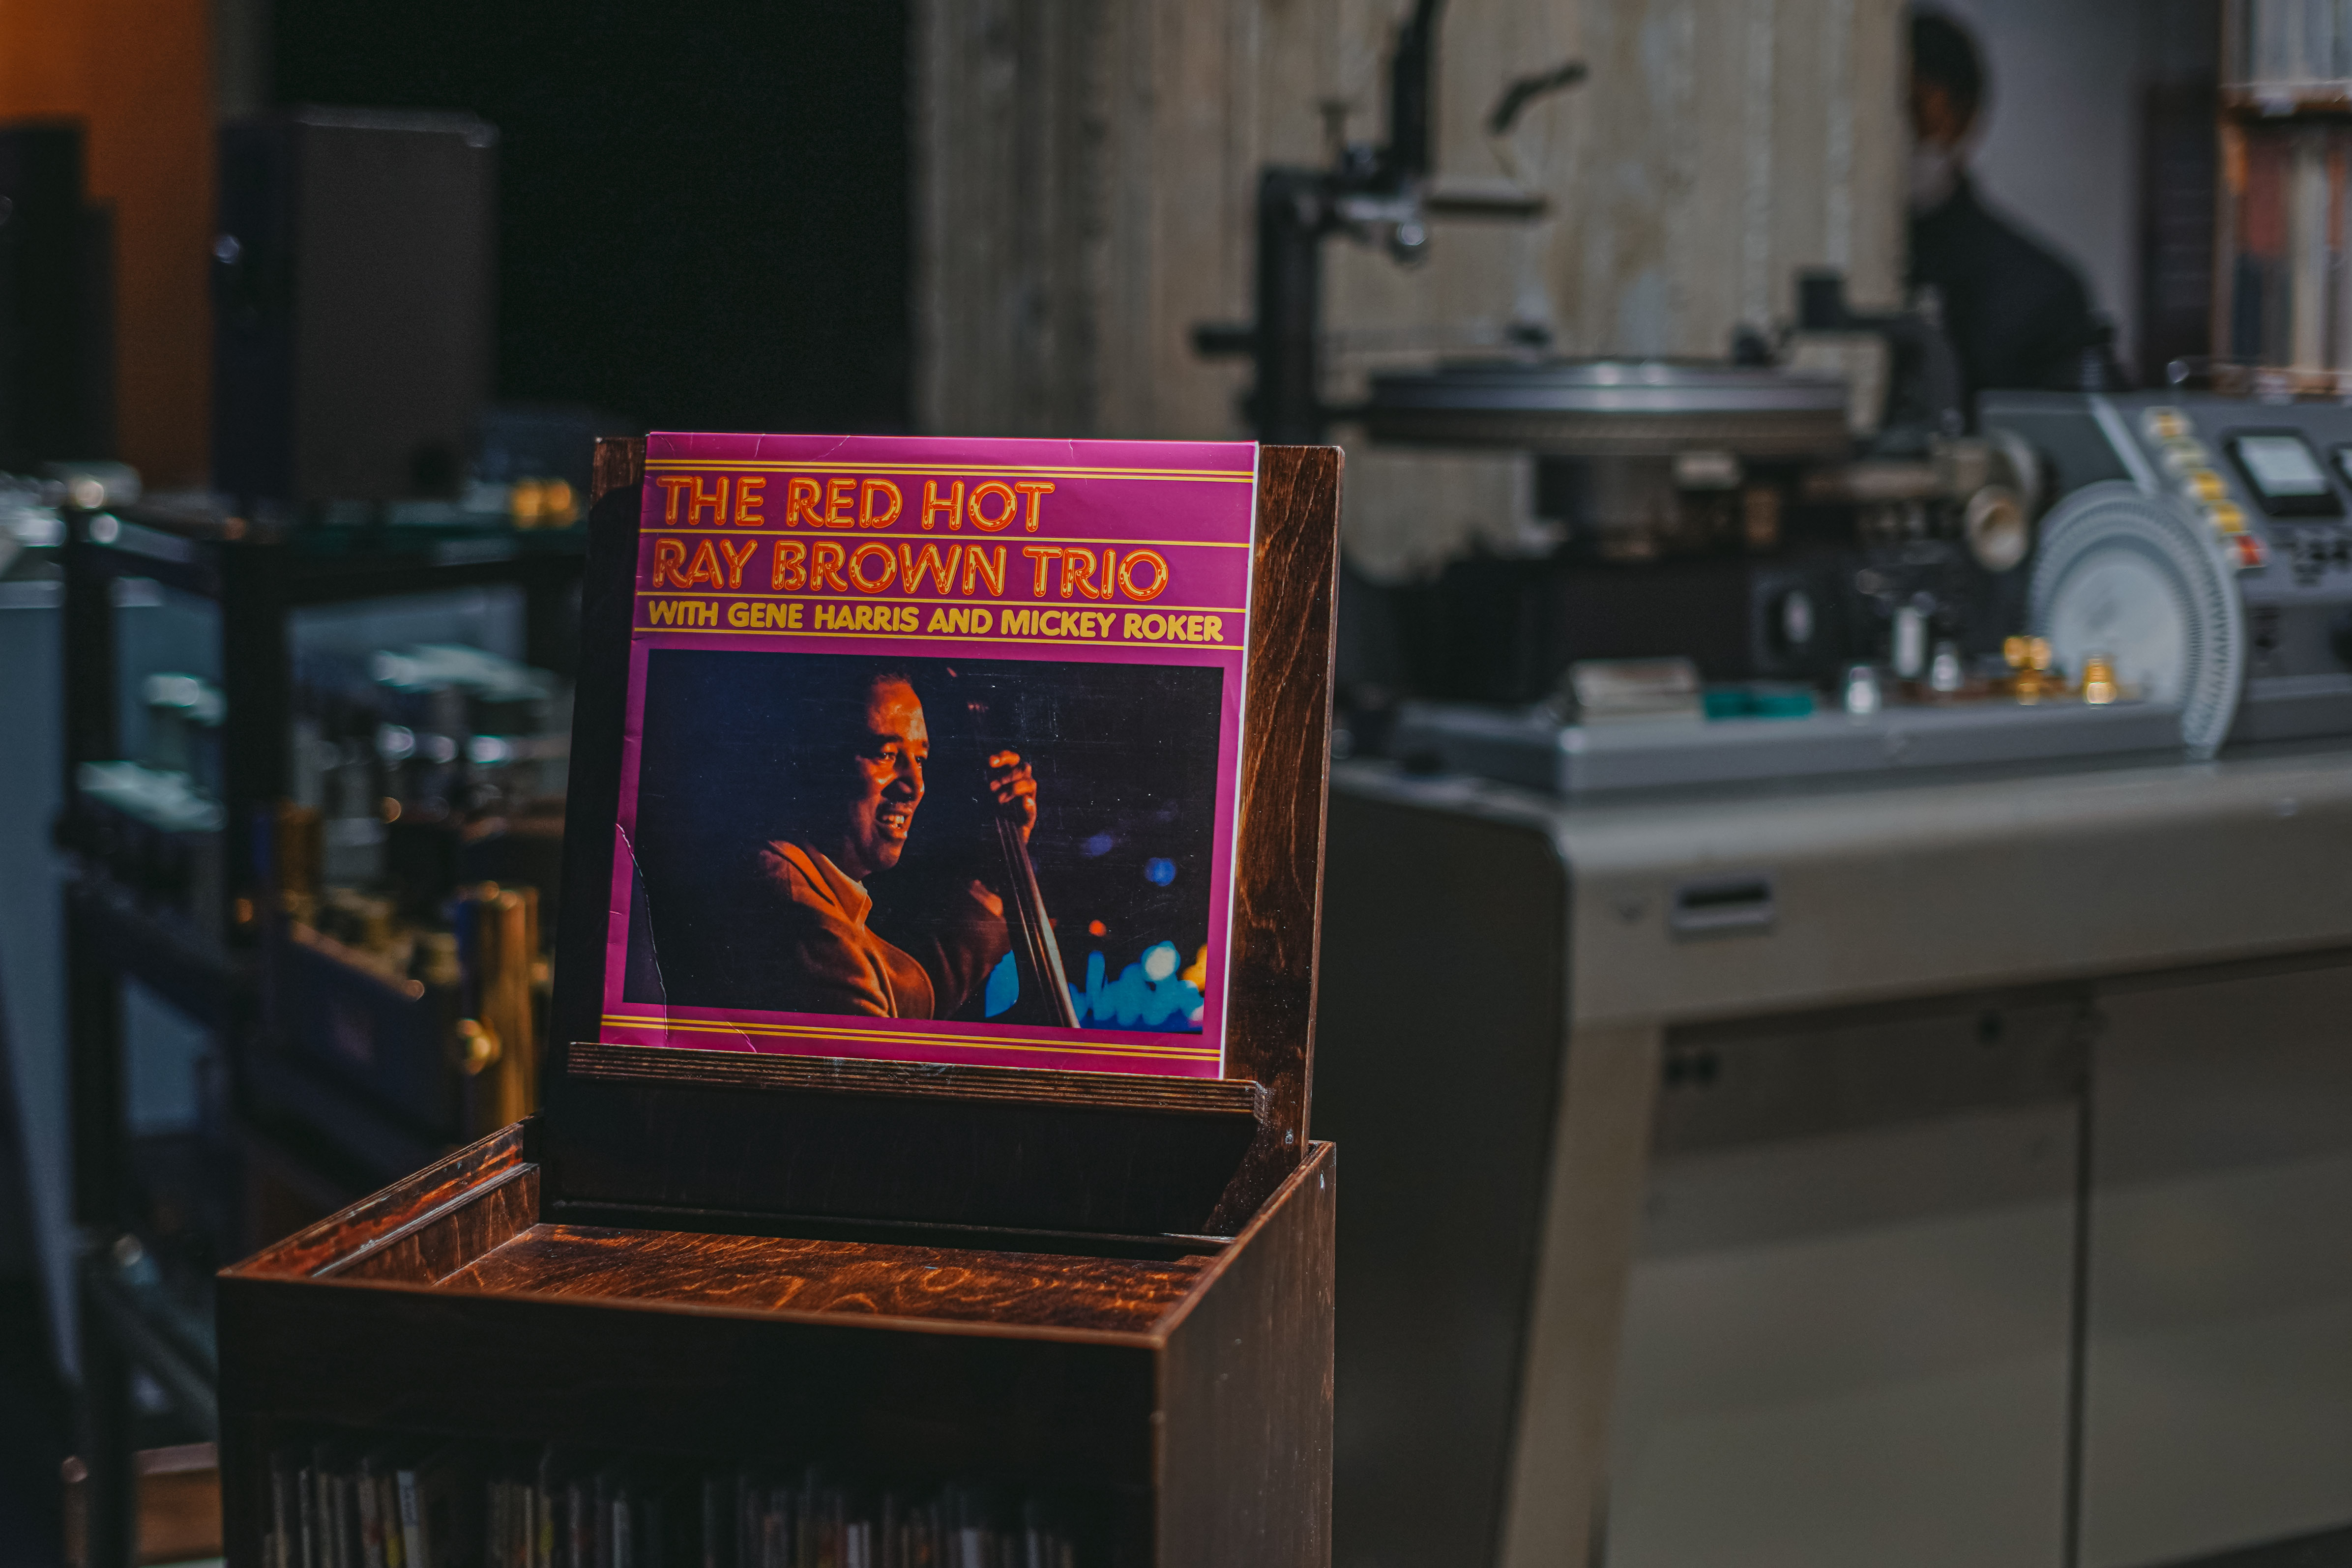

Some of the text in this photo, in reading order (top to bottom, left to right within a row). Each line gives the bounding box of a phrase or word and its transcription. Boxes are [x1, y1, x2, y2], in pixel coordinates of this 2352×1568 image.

[657, 475, 1056, 533] THE RED HOT
[652, 538, 1169, 602] RAY BROWN TRIO
[649, 600, 1224, 642] WITH GENE HARRIS AND MICKEY ROKER
